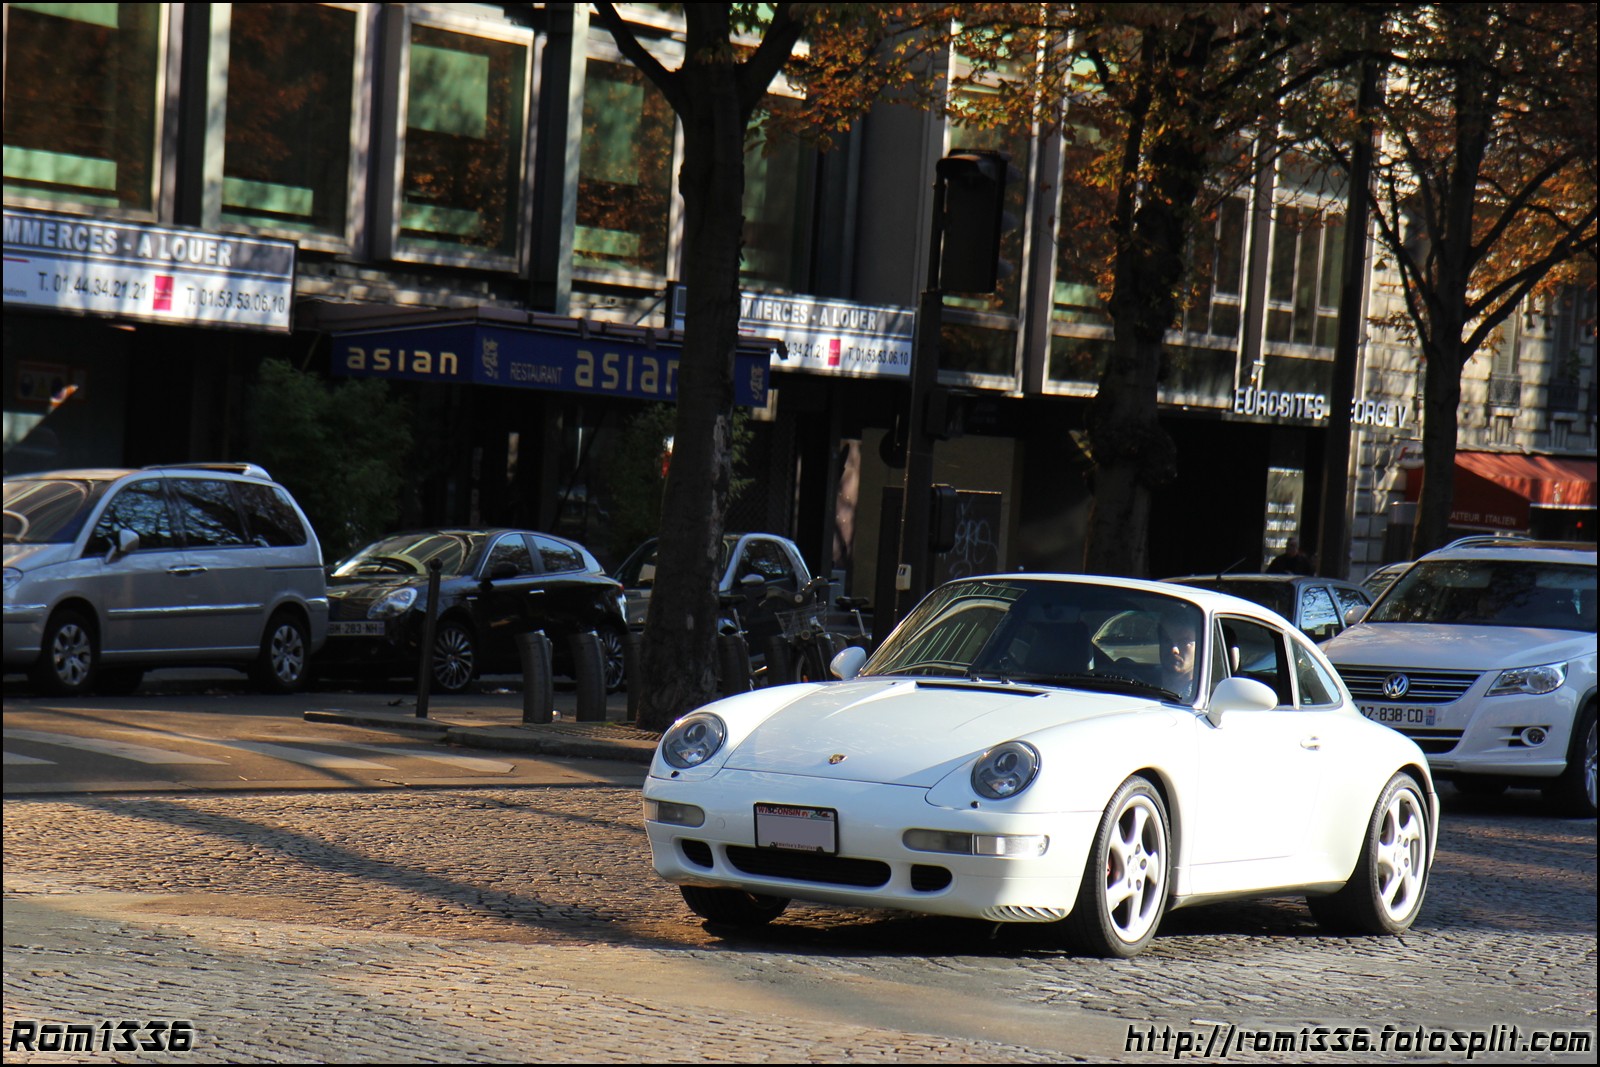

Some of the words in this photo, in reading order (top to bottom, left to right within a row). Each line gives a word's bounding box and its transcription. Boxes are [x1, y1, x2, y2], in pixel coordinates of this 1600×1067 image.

[138, 233, 153, 258] A
[158, 236, 232, 266] LOUER
[54, 274, 147, 300] 01.44.34.21.21
[200, 288, 285, 313] 01.53.53.06.10
[820, 307, 829, 325] A
[833, 309, 876, 330] LOUER
[346, 347, 459, 375] asian
[856, 348, 909, 366] 01.53.53.06.10
[509, 361, 563, 384] RESTAURANT
[1397, 405, 1407, 428] V
[1484, 513, 1517, 526] ITALIEN
[758, 806, 801, 816] WISCONSIN
